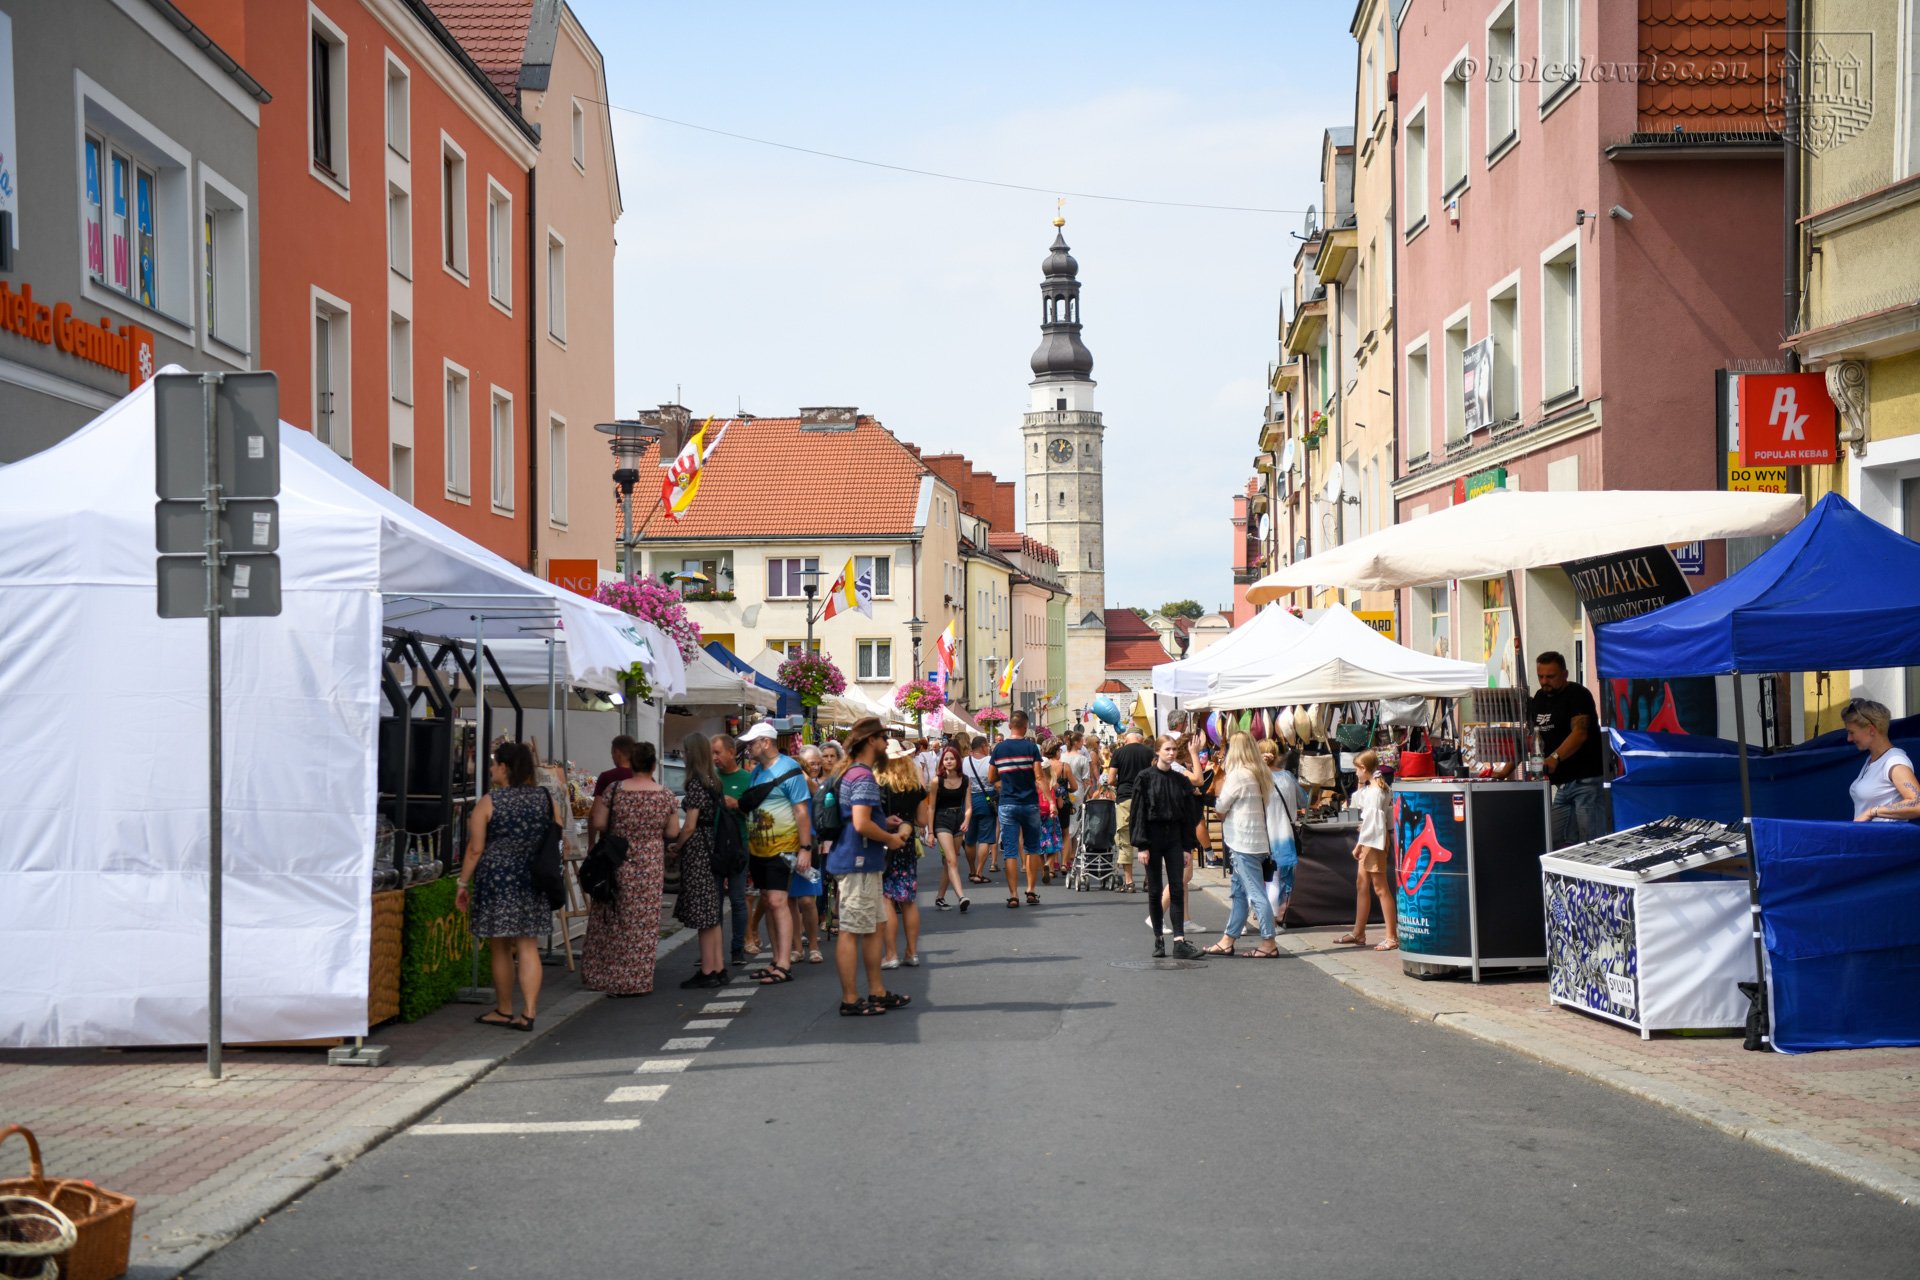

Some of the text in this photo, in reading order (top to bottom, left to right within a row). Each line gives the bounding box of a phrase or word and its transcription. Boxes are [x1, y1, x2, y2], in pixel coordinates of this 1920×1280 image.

[53, 301, 129, 375] Gemini
[1754, 448, 1829, 460] POPULAR KEBAB
[1731, 470, 1786, 481] DO WYN
[554, 576, 592, 591] ING
[1571, 556, 1660, 602] OSTRZAŁKI
[1361, 619, 1392, 631] ARD
[1609, 977, 1633, 996] SYLVIA
